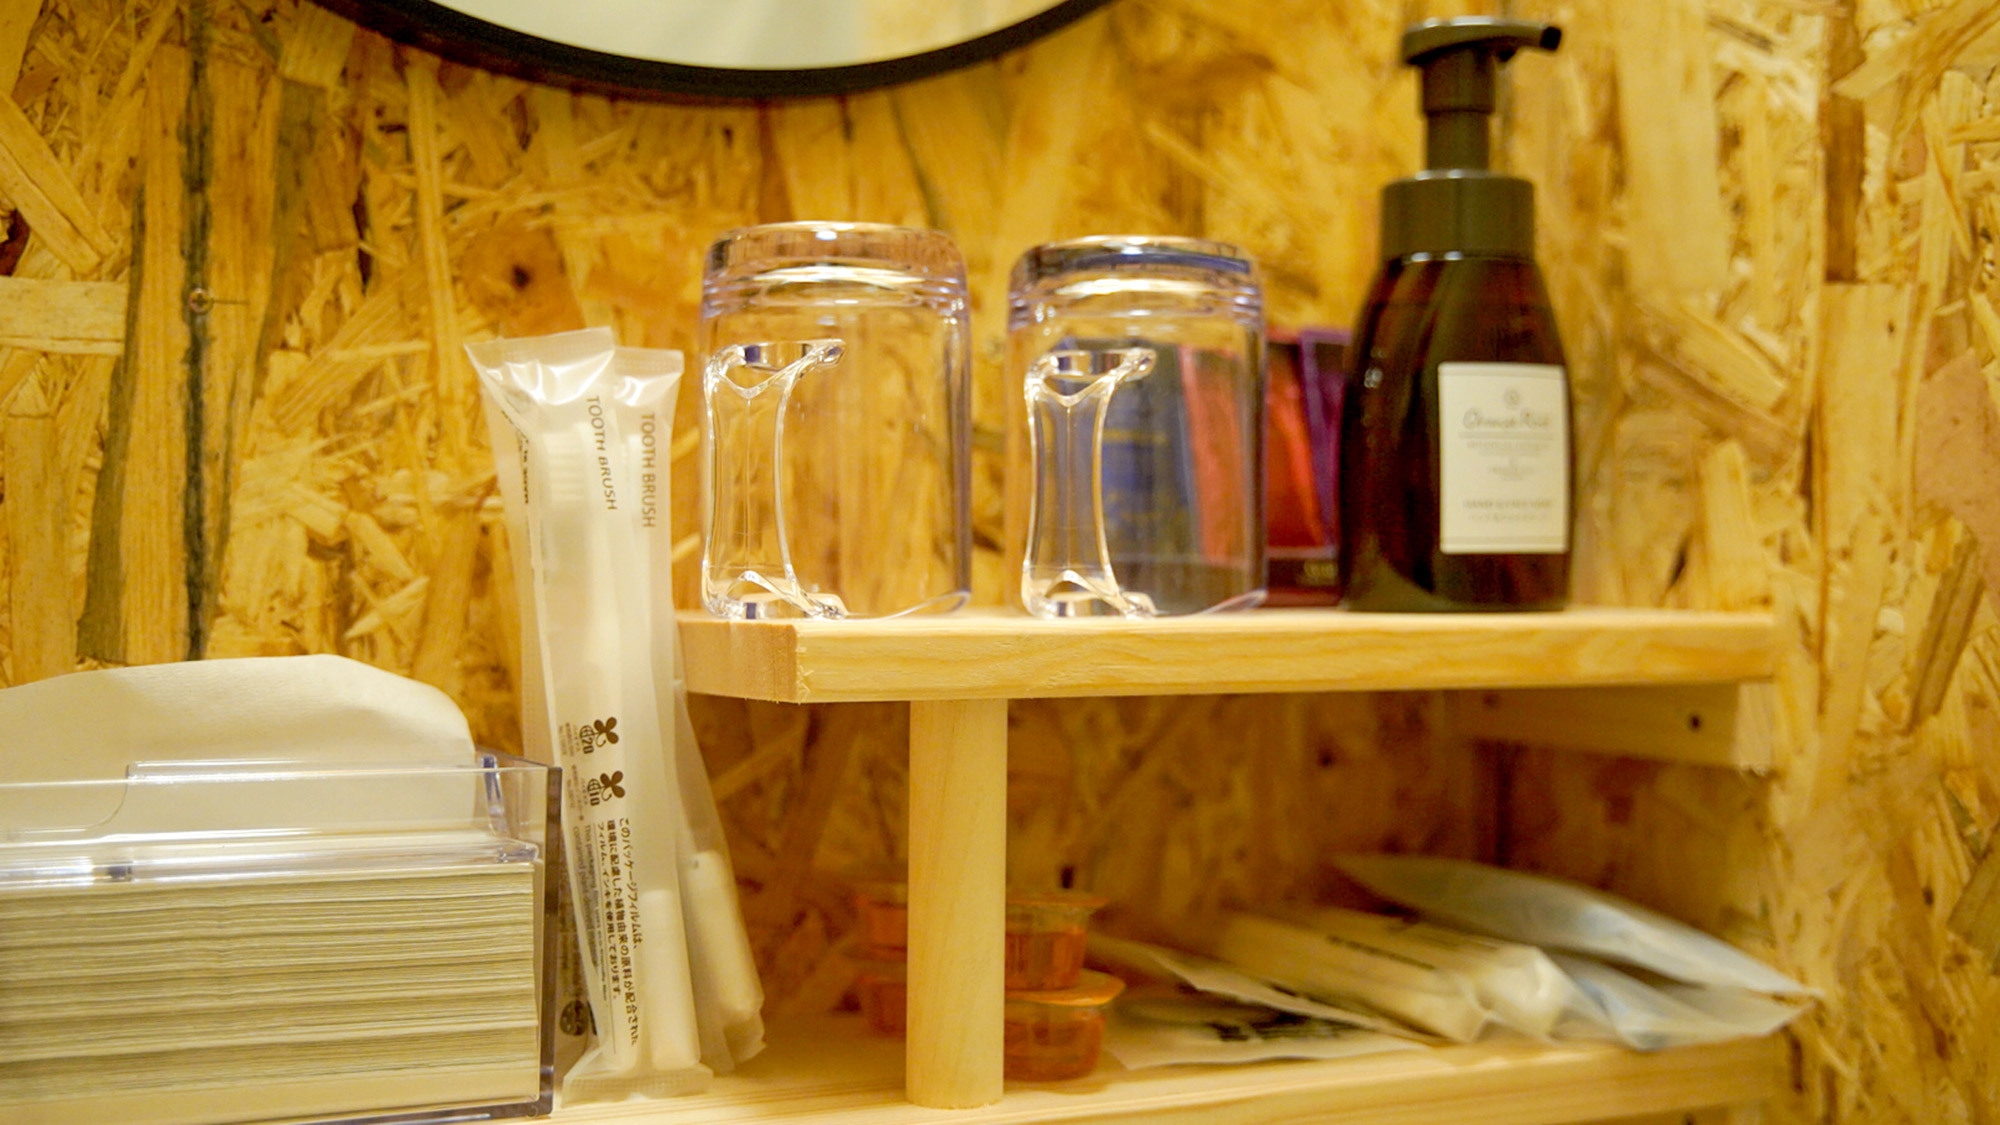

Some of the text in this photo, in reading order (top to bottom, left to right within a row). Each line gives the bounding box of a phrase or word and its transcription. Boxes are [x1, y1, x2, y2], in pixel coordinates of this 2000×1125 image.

[586, 395, 618, 510] TOOTH BRUSH
[641, 412, 656, 528] TOOTH BRUSH
[582, 736, 595, 755] 20
[589, 791, 601, 807] 10
